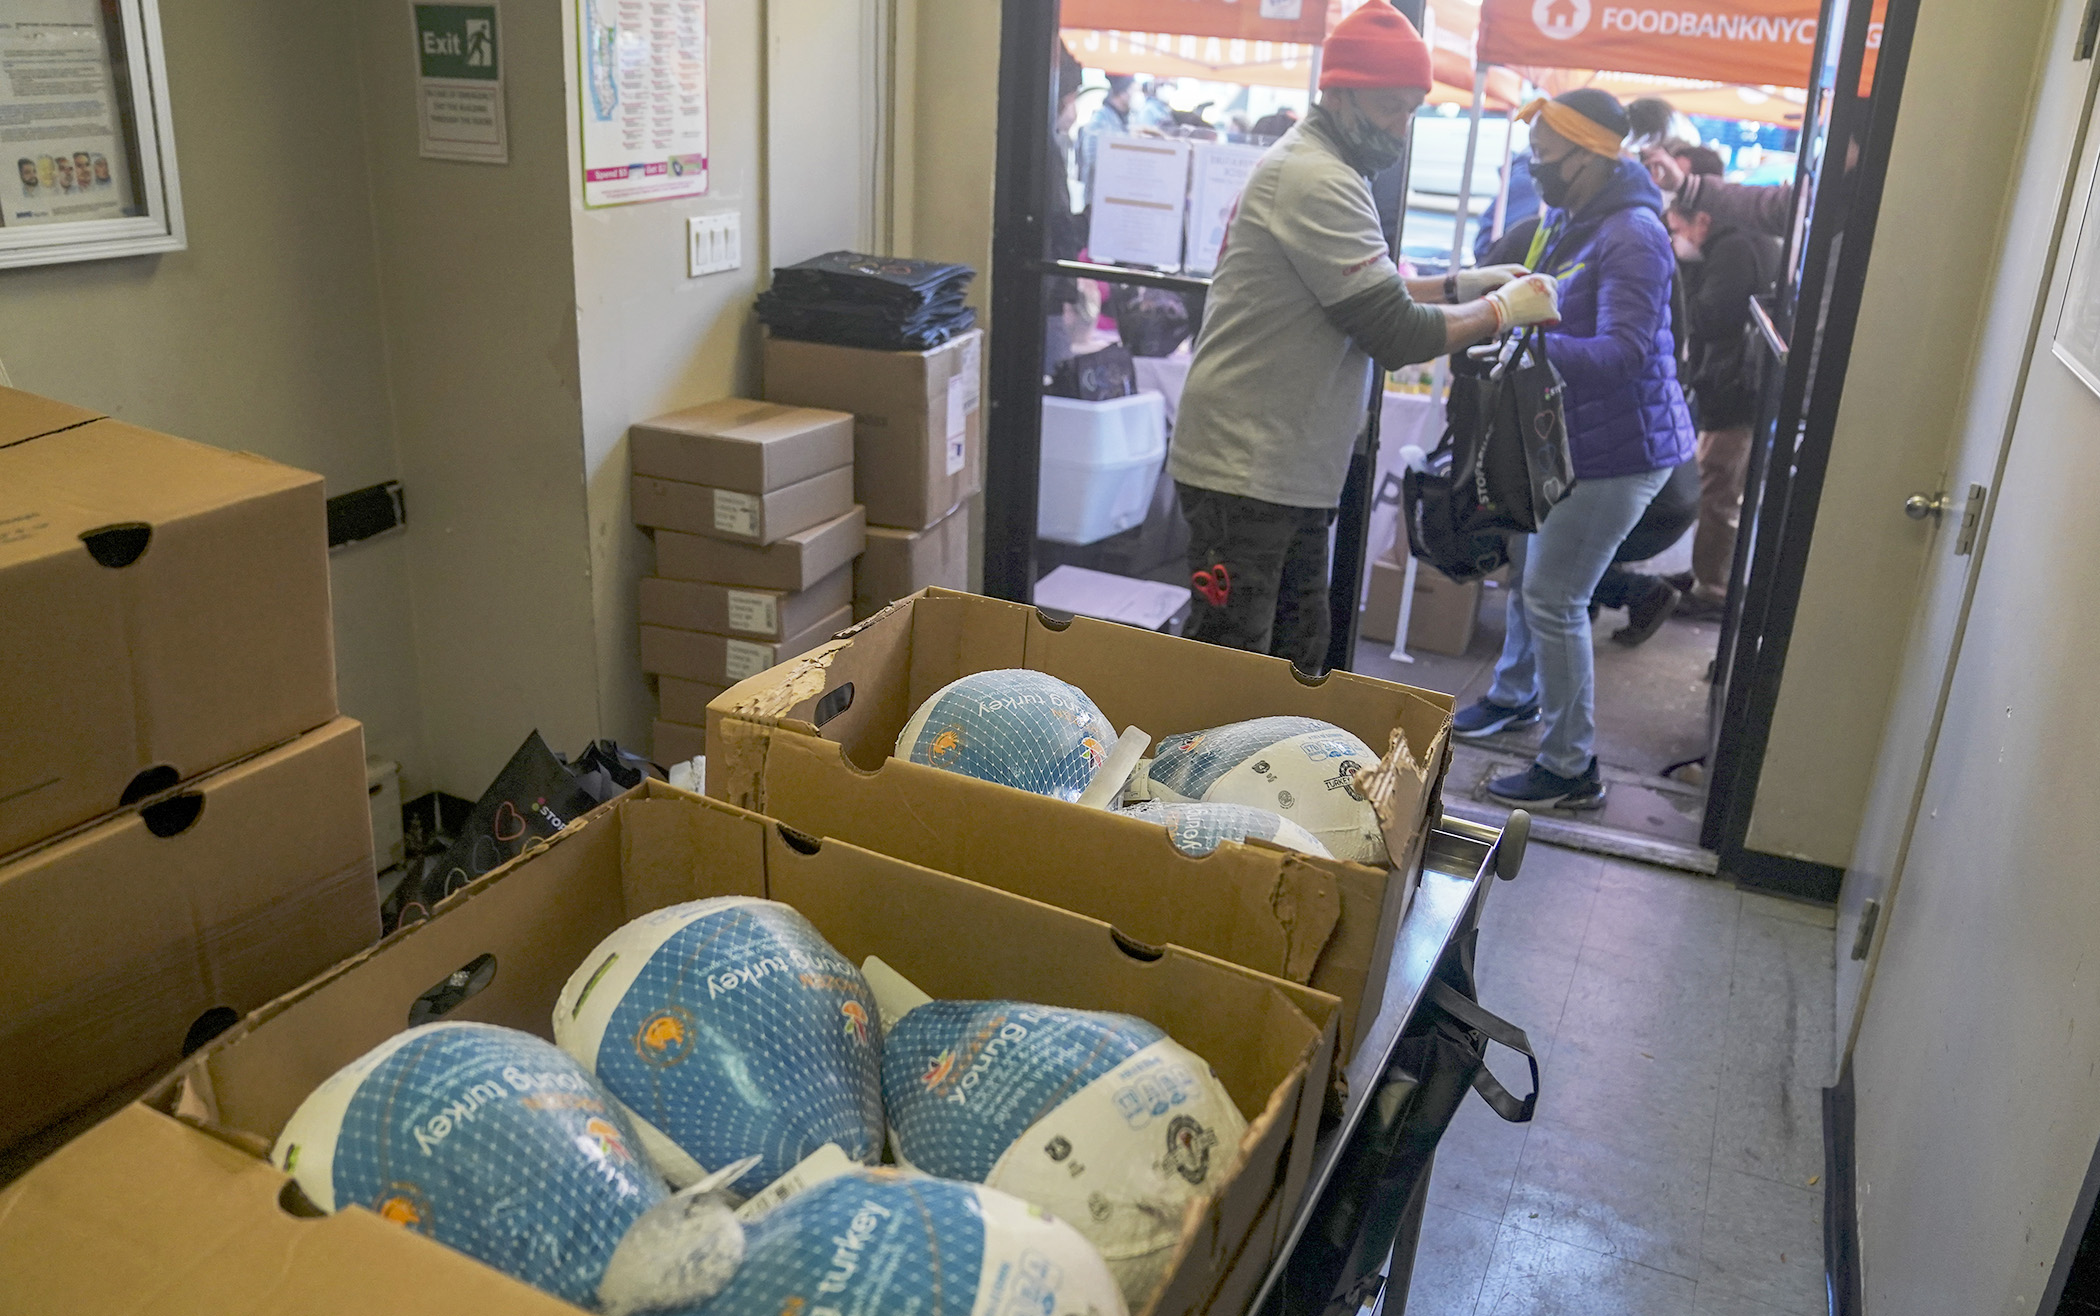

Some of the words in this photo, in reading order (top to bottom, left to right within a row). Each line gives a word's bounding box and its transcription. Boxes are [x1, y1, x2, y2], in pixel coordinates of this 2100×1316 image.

[423, 31, 462, 56] Exit
[978, 695, 1046, 717] turkey
[1325, 777, 1351, 790] TURKEY
[706, 955, 789, 1000] turkey
[947, 1022, 1029, 1107] young
[413, 1078, 509, 1158] turkey
[817, 1198, 892, 1294] turkey
